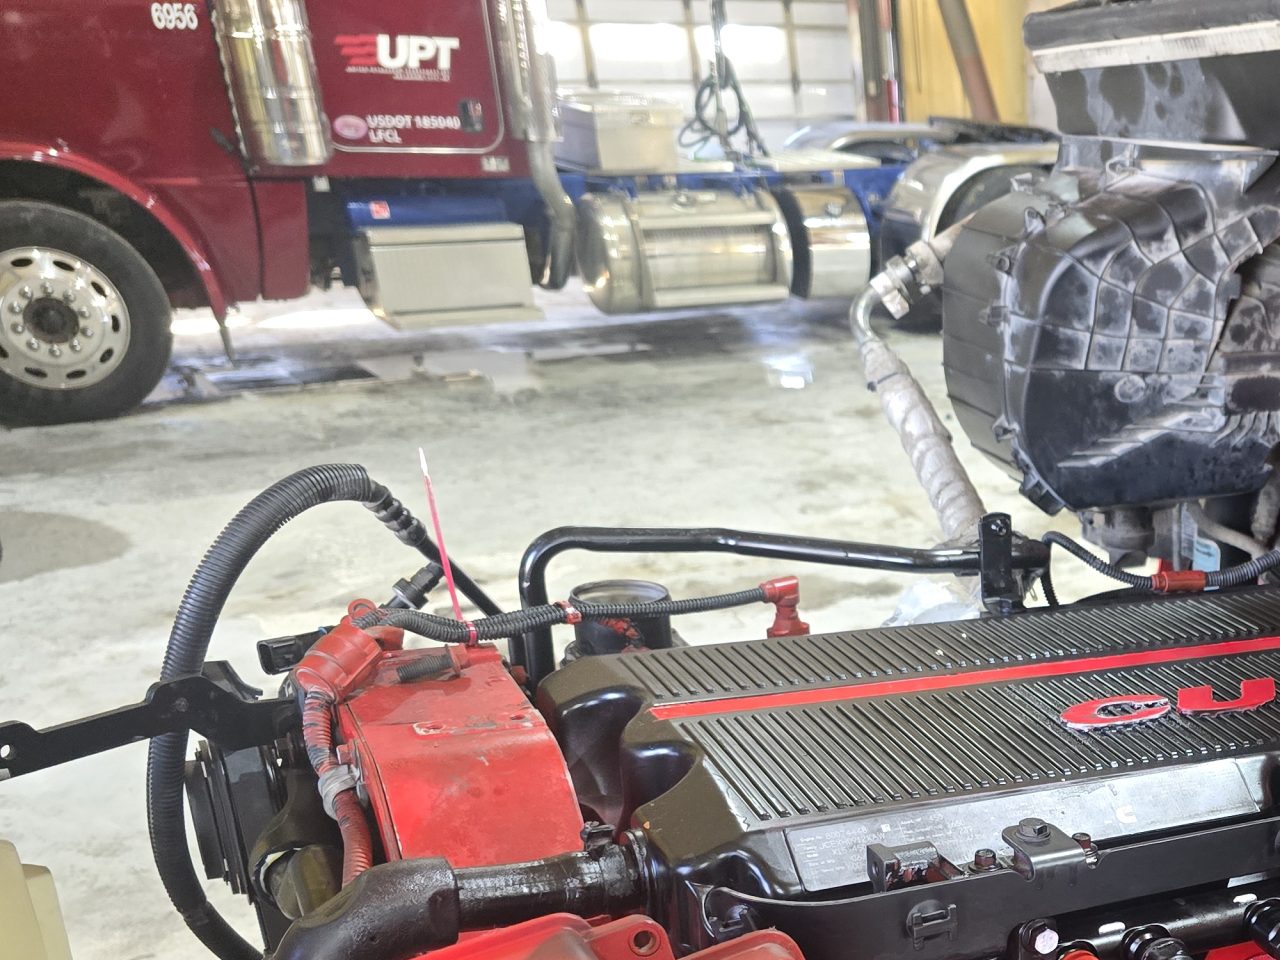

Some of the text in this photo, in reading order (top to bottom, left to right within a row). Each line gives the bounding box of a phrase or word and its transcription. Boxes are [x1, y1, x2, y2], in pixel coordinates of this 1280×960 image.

[151, 3, 198, 30] 6956
[376, 33, 460, 69] UPT
[366, 114, 412, 129] USDOT
